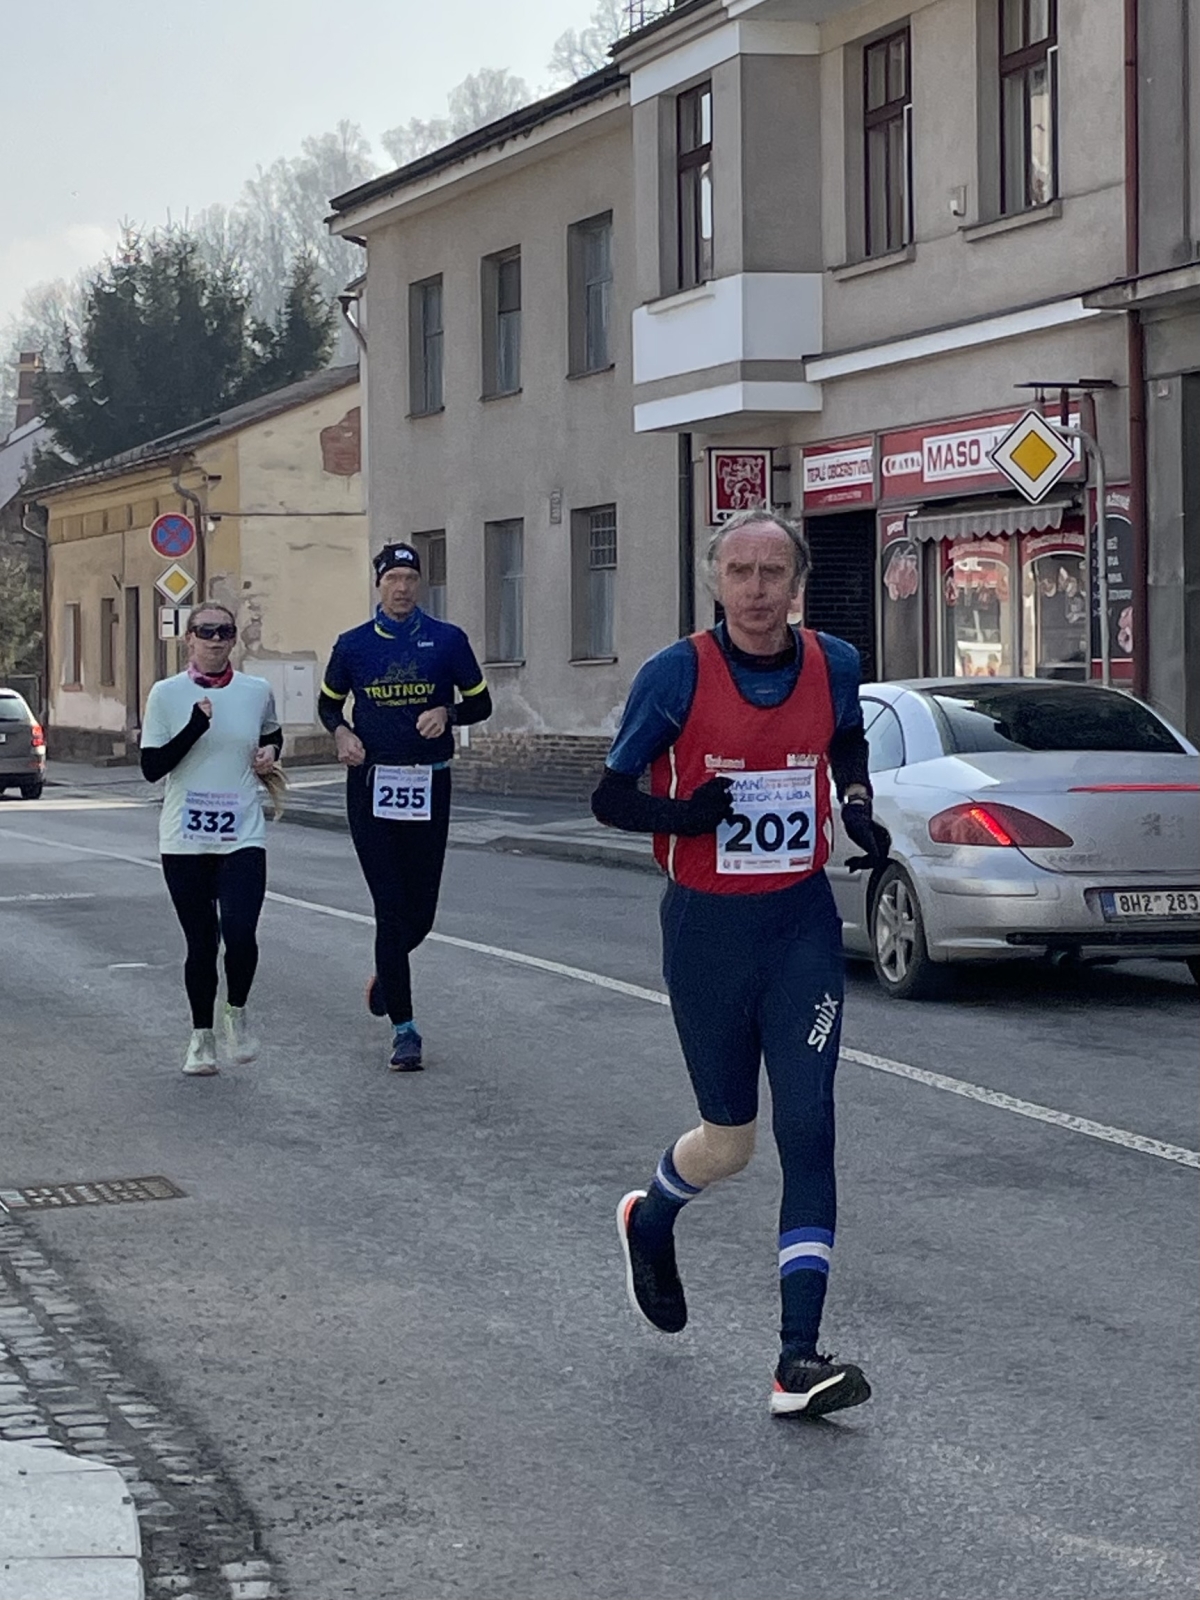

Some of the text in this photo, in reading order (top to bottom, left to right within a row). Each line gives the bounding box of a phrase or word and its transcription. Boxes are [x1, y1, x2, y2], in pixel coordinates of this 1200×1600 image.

[927, 438, 981, 473] MASO
[364, 683, 436, 699] TRUTNOV
[378, 786, 426, 809] 255
[187, 809, 236, 833] 332
[724, 811, 811, 853] 202
